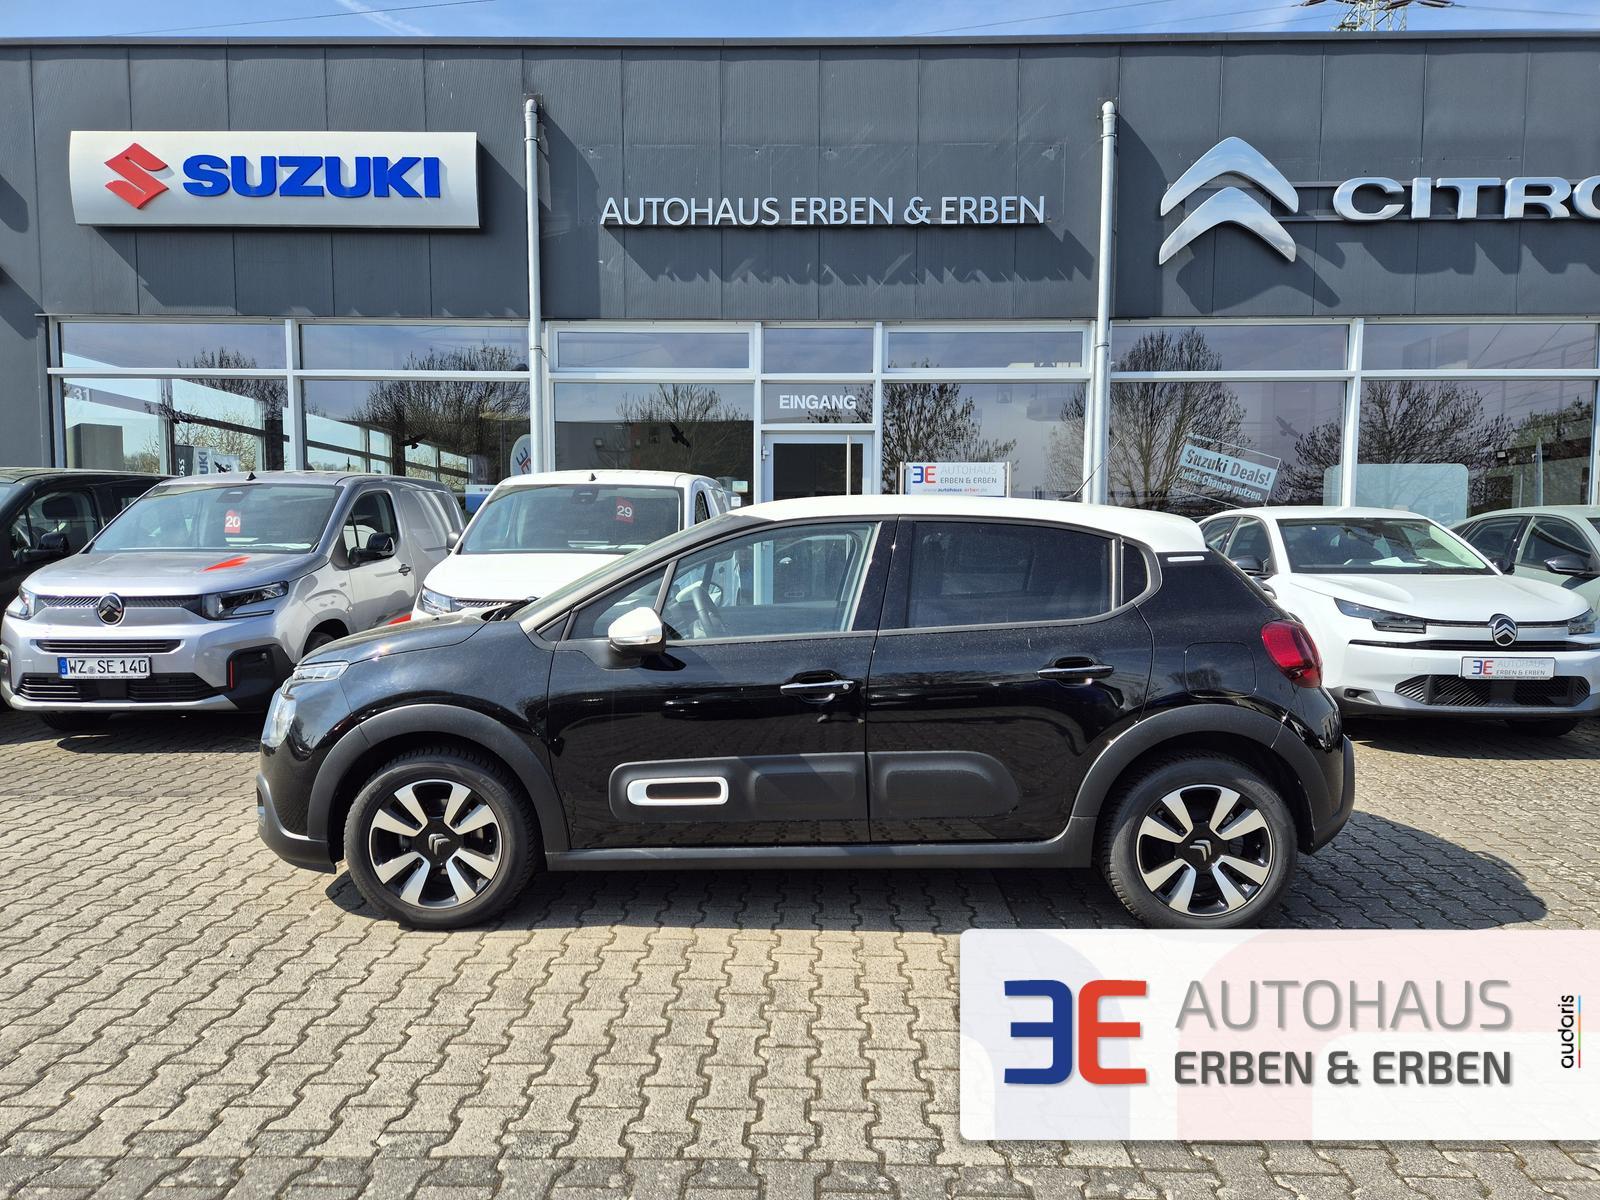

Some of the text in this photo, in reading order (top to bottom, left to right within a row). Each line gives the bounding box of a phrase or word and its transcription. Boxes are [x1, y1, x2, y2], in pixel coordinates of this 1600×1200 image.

[182, 154, 441, 199] SUZUKI
[600, 195, 1045, 225] AUTOHAUS ERBEN & ERBEN
[779, 394, 857, 409] EINGANG
[940, 465, 998, 475] AUTOHAUS
[1186, 448, 1272, 486] Suzuki Deals!
[1202, 475, 1233, 492] Chance
[1233, 486, 1263, 501] nutzen.
[616, 505, 633, 518] 29
[225, 515, 241, 528] 20
[68, 660, 147, 674] WZ SE 140
